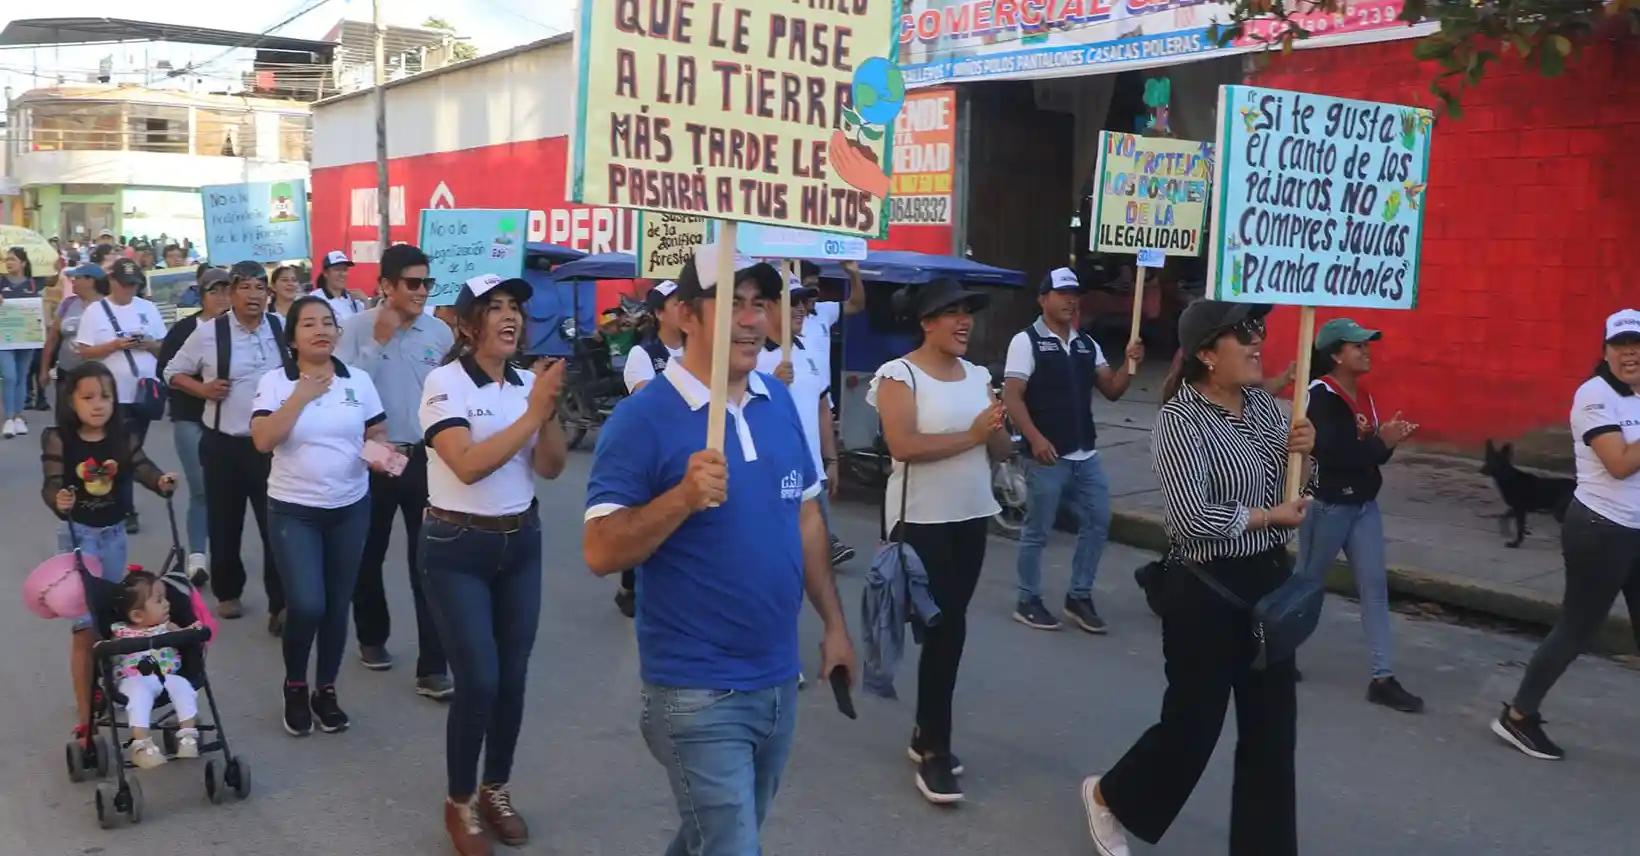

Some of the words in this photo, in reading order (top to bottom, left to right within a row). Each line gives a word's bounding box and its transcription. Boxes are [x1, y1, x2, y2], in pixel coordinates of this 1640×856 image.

[899, 0, 1101, 43] COMERCIAL
[1357, 5, 1396, 26] 239
[615, 0, 694, 43] QUE
[708, 2, 751, 54] LE
[766, 13, 853, 72] PASE
[1017, 49, 1083, 70] PANTALONES
[1086, 44, 1140, 64] CASACAS
[1142, 34, 1200, 57] POLERAS
[614, 48, 640, 99] A
[655, 53, 698, 106] LA
[1291, 94, 1315, 135] te
[1324, 102, 1397, 144] gusta
[610, 105, 673, 163] MÁS
[685, 122, 779, 174] TARDE
[792, 138, 828, 180] LE
[1246, 131, 1271, 168] el
[1278, 135, 1337, 175] canto
[1343, 143, 1371, 180] de
[1377, 145, 1413, 183] los
[607, 163, 709, 212] PASARÁ
[716, 176, 734, 213] A
[740, 178, 789, 220] TUS
[1105, 171, 1136, 196] LOS
[1137, 174, 1206, 204] BOSQUES
[429, 217, 444, 237] No
[457, 218, 468, 236] la
[646, 221, 661, 238] de
[662, 223, 677, 236] la
[1125, 200, 1150, 225] DE
[1154, 202, 1175, 226] LA
[1099, 223, 1197, 252] ILEGALIDAD!
[1339, 215, 1410, 258] jaulas
[464, 259, 475, 272] la
[648, 246, 694, 273] forestal
[1242, 251, 1321, 294] Planta
